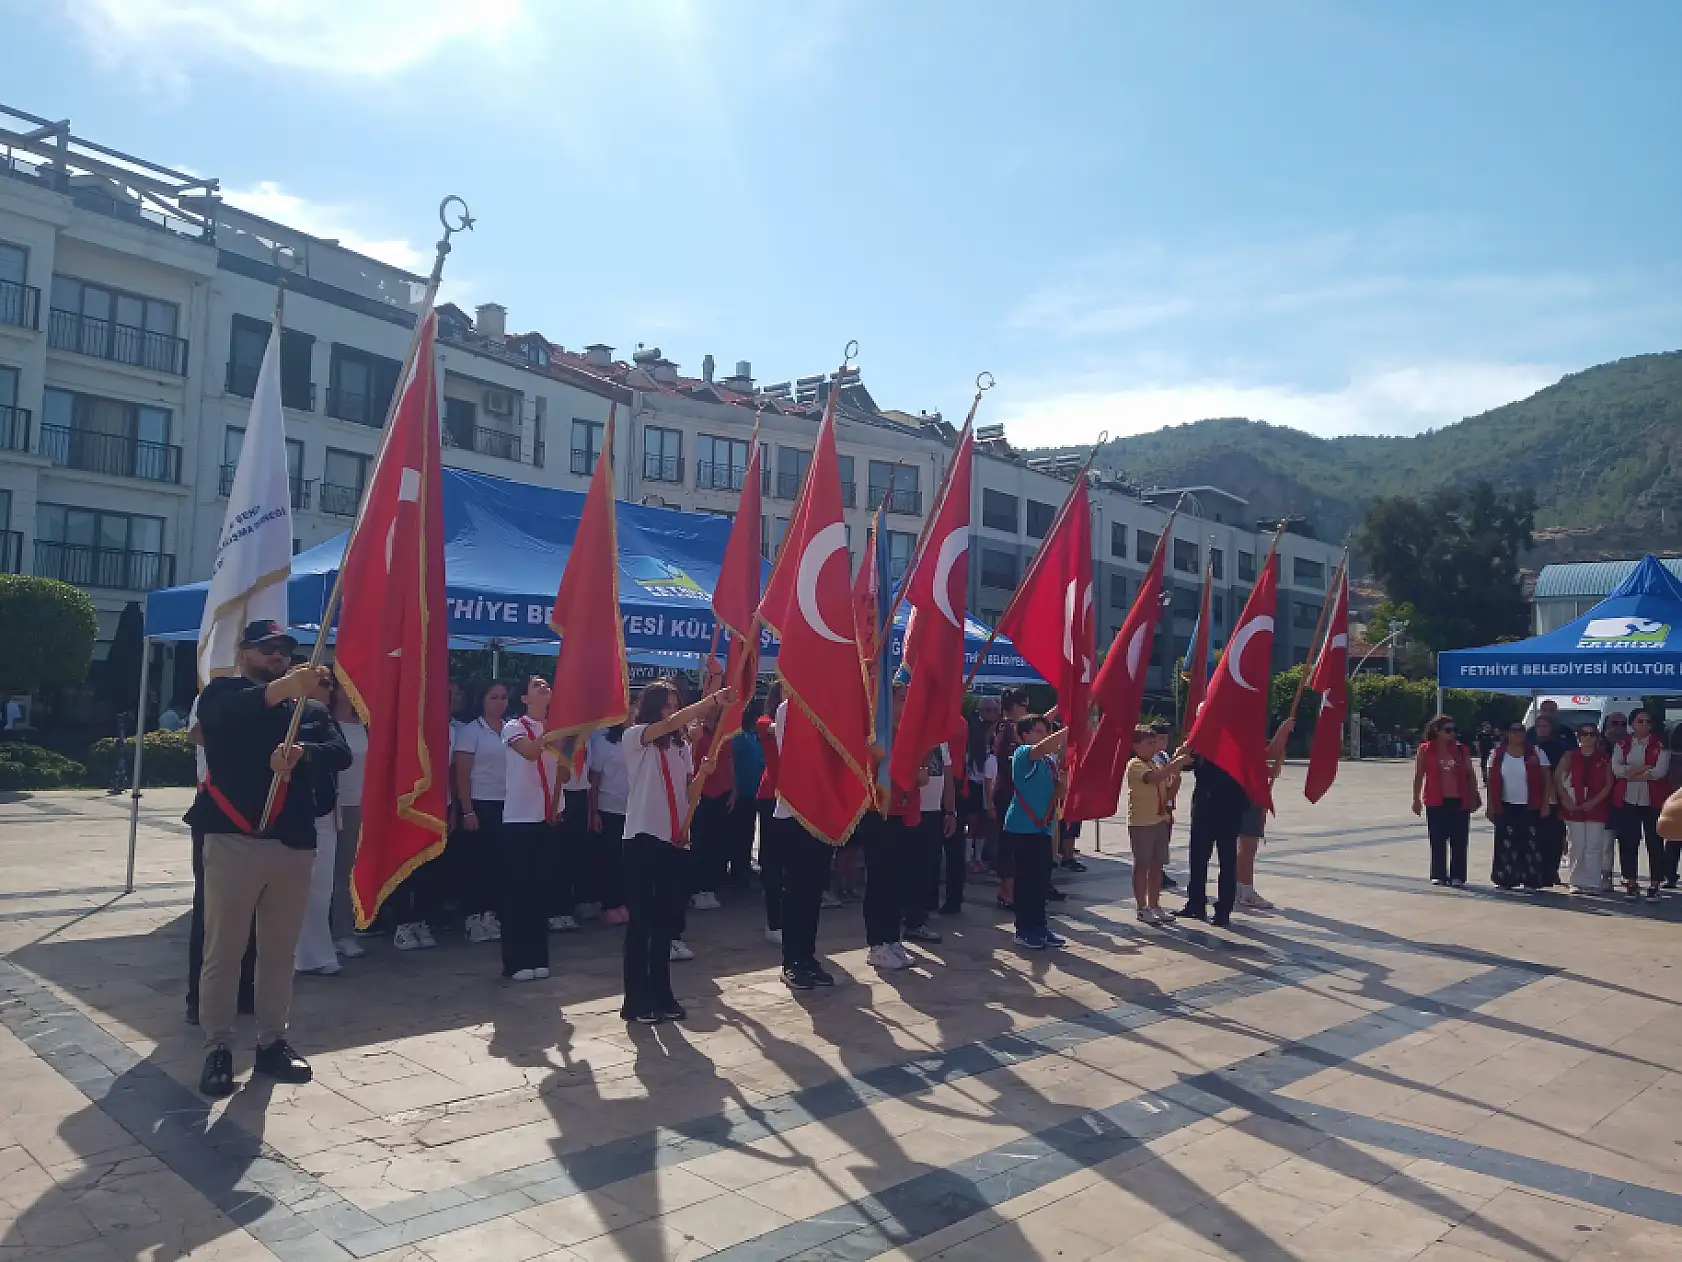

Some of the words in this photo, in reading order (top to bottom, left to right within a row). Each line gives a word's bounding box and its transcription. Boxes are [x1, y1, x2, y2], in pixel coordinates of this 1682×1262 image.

[1460, 662, 1519, 676] FETHİYE
[1523, 660, 1607, 675] BELEDİYESİ
[1611, 662, 1675, 676] KÜLTÜR
